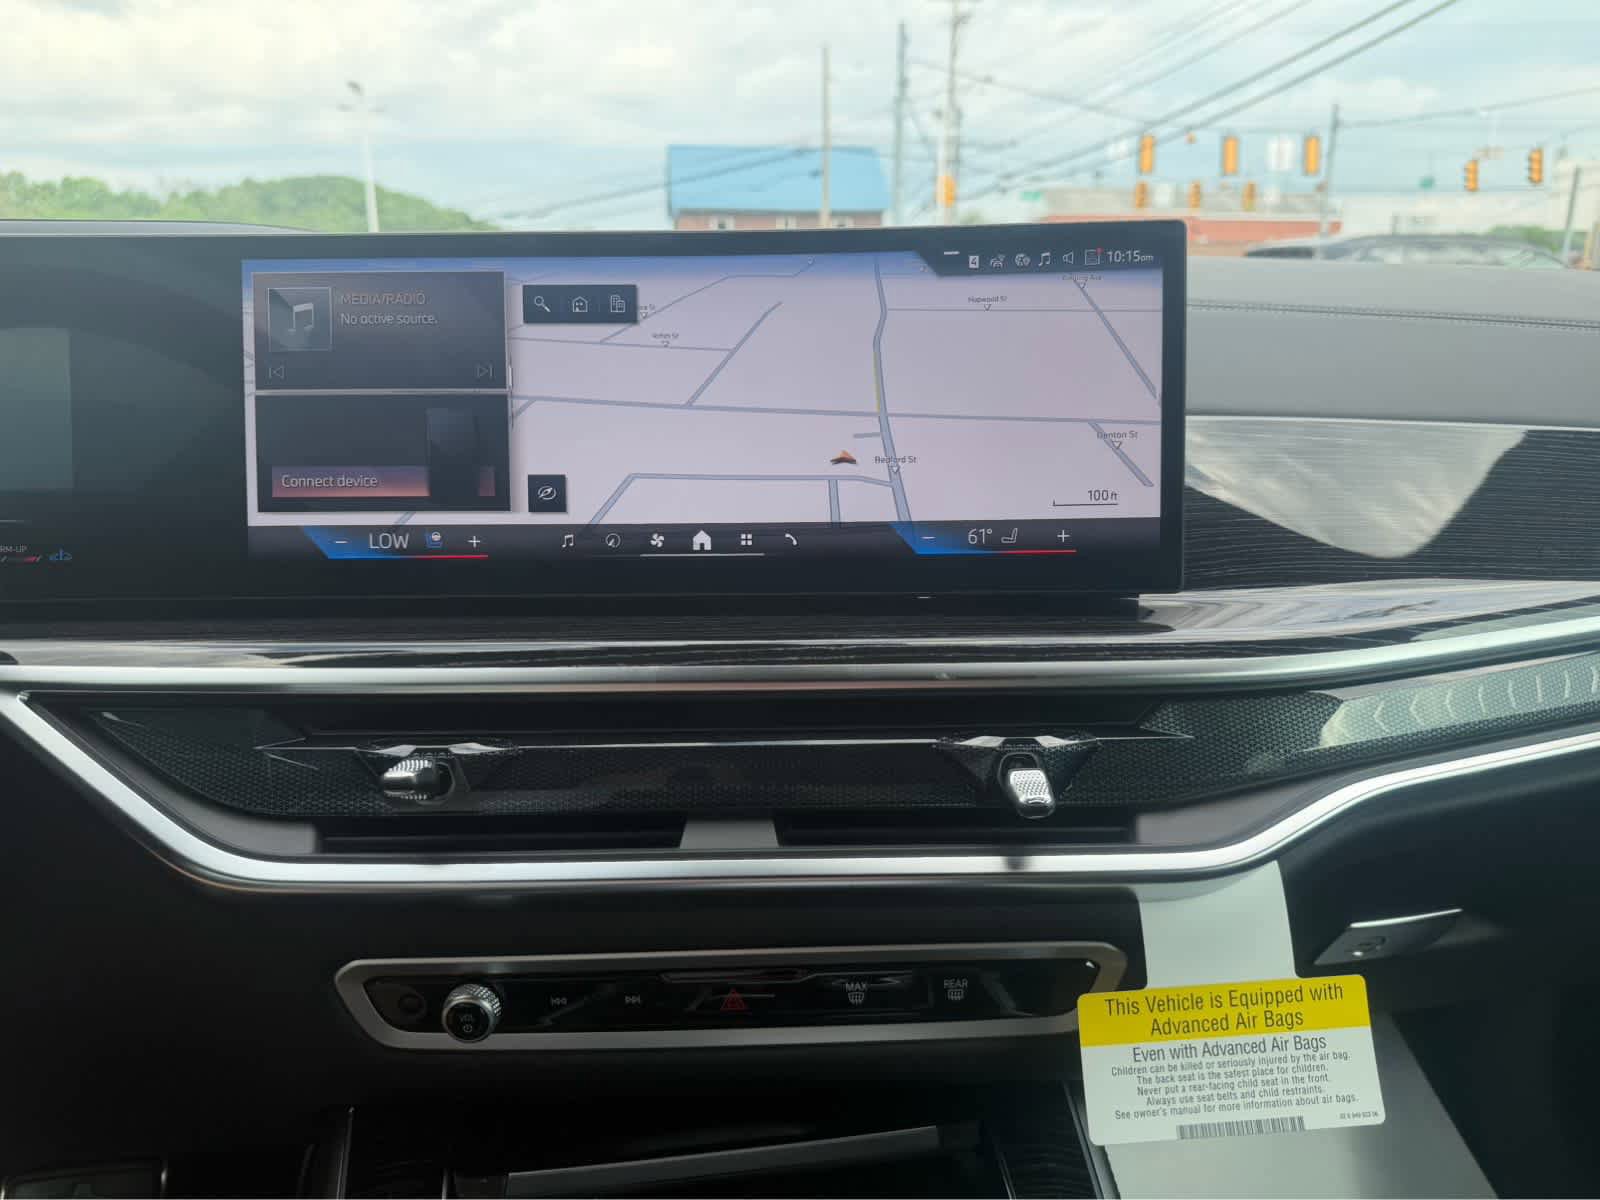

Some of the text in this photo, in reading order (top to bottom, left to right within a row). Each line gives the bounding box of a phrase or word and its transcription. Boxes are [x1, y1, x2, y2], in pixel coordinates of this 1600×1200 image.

[1106, 250, 1154, 262] 10:15pm
[340, 292, 426, 305] MEDIA/RADIO
[340, 312, 438, 325] No active source.
[1128, 430, 1139, 439] St
[907, 455, 917, 464] St
[281, 474, 378, 488] Connect device
[368, 532, 410, 549] LOW
[967, 528, 993, 545] 61°
[845, 981, 868, 992] MAX
[943, 978, 969, 988] REAR
[1104, 983, 1344, 1016] This Vehicle is Equipped with
[1150, 1010, 1304, 1036] Advanced Air Bags
[1133, 1035, 1327, 1063] Even with Advanced Air Bags
[1112, 1050, 1351, 1077] Children can be killed or seriously injured by the air bag.
[1137, 1063, 1329, 1085] The back seat is the safest place for children.
[1137, 1086, 1162, 1097] Never
[1164, 1085, 1179, 1096] put
[1189, 1081, 1235, 1093] rear-facing
[1237, 1078, 1259, 1089] child
[1260, 1077, 1279, 1087] seat
[1281, 1075, 1290, 1085] in
[1291, 1075, 1305, 1084] the
[1146, 1096, 1176, 1107] Always
[1179, 1095, 1194, 1104] use
[1196, 1094, 1215, 1103] seat
[1216, 1091, 1238, 1102] belts
[1240, 1089, 1256, 1099] and
[1258, 1087, 1280, 1098] child
[1114, 1093, 1360, 1120] See owner's manual for more information about air bags.
